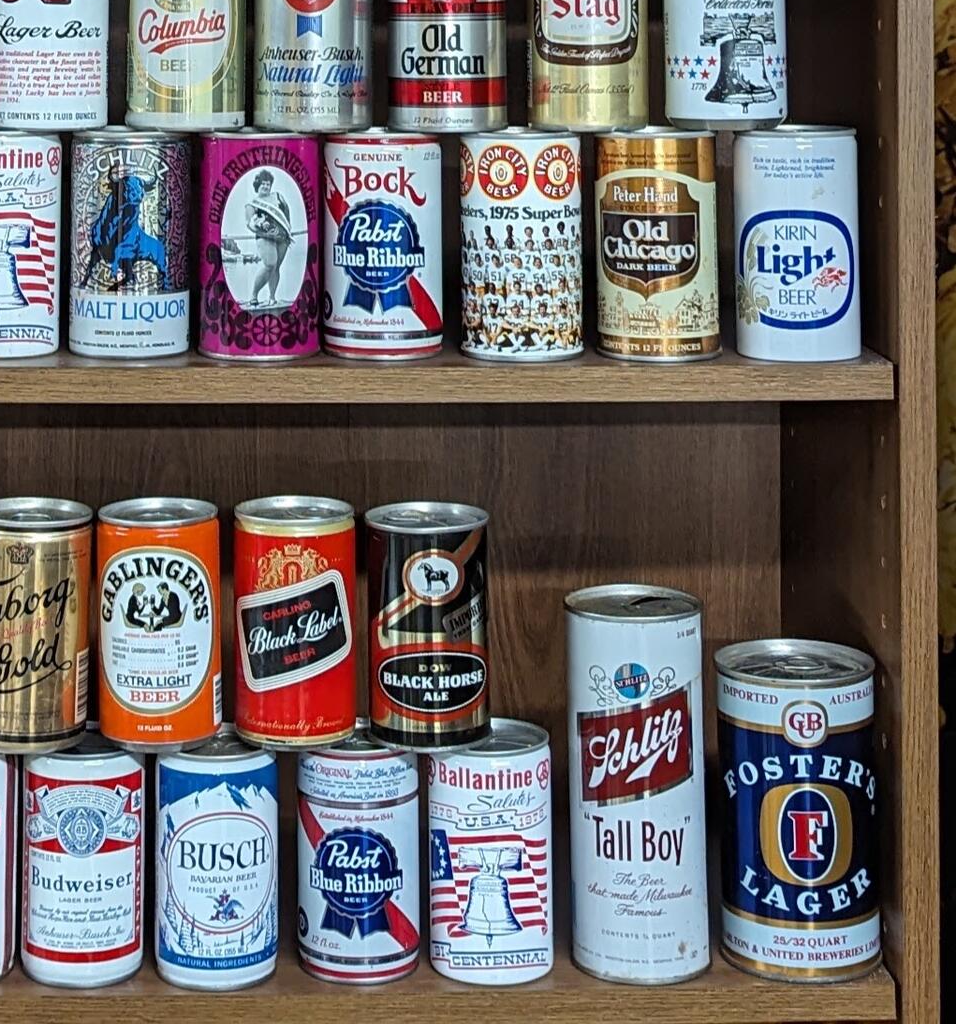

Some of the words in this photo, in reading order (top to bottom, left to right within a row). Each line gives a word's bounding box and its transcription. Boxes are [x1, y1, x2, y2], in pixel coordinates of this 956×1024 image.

[55, 20, 101, 39] Beer
[138, 8, 226, 45] Columbia
[421, 24, 463, 52] Old
[263, 62, 321, 82] Natural
[401, 47, 485, 76] German
[423, 91, 463, 103] BEER
[7, 112, 40, 120] CONTENTS
[85, 152, 169, 182] SCHLITZ
[354, 153, 402, 162] GENUINE
[334, 159, 426, 206] Bock
[613, 186, 641, 202] Peter
[644, 187, 677, 202] Hand
[490, 207, 519, 219] 1975
[522, 206, 560, 222] Super
[349, 214, 404, 242] Pabst
[623, 219, 669, 241] Old
[774, 225, 816, 240] KIRIN
[334, 246, 365, 266] Blue
[367, 246, 424, 268] Ribbon
[604, 236, 695, 263] Chicago
[757, 244, 836, 286] Light
[779, 290, 816, 305] BEER
[75, 300, 117, 318] MALT
[122, 299, 185, 322] LIQUOR
[102, 557, 209, 622] GABLINGER'S
[248, 627, 296, 654] Black
[297, 606, 339, 643] Label
[117, 675, 153, 686] EXTRA
[157, 675, 192, 686] LIGHT
[384, 672, 434, 689] BLACK
[438, 670, 483, 688] HORSE
[130, 691, 180, 702] BEER
[424, 692, 449, 701] ALE
[588, 707, 683, 788] Schlitz
[439, 761, 533, 789] Ballantine
[724, 755, 876, 800] FOSTER'S
[177, 837, 266, 871] BUSCH
[327, 840, 382, 868] Pabst
[32, 866, 131, 893] Budweiser
[312, 868, 343, 891] Blue
[345, 871, 401, 894] Ribbon
[740, 865, 871, 915] LAGER
[453, 954, 546, 966] CENTENNIAL
[762, 947, 804, 960] UNITED
[808, 946, 863, 960] BREWERIES
